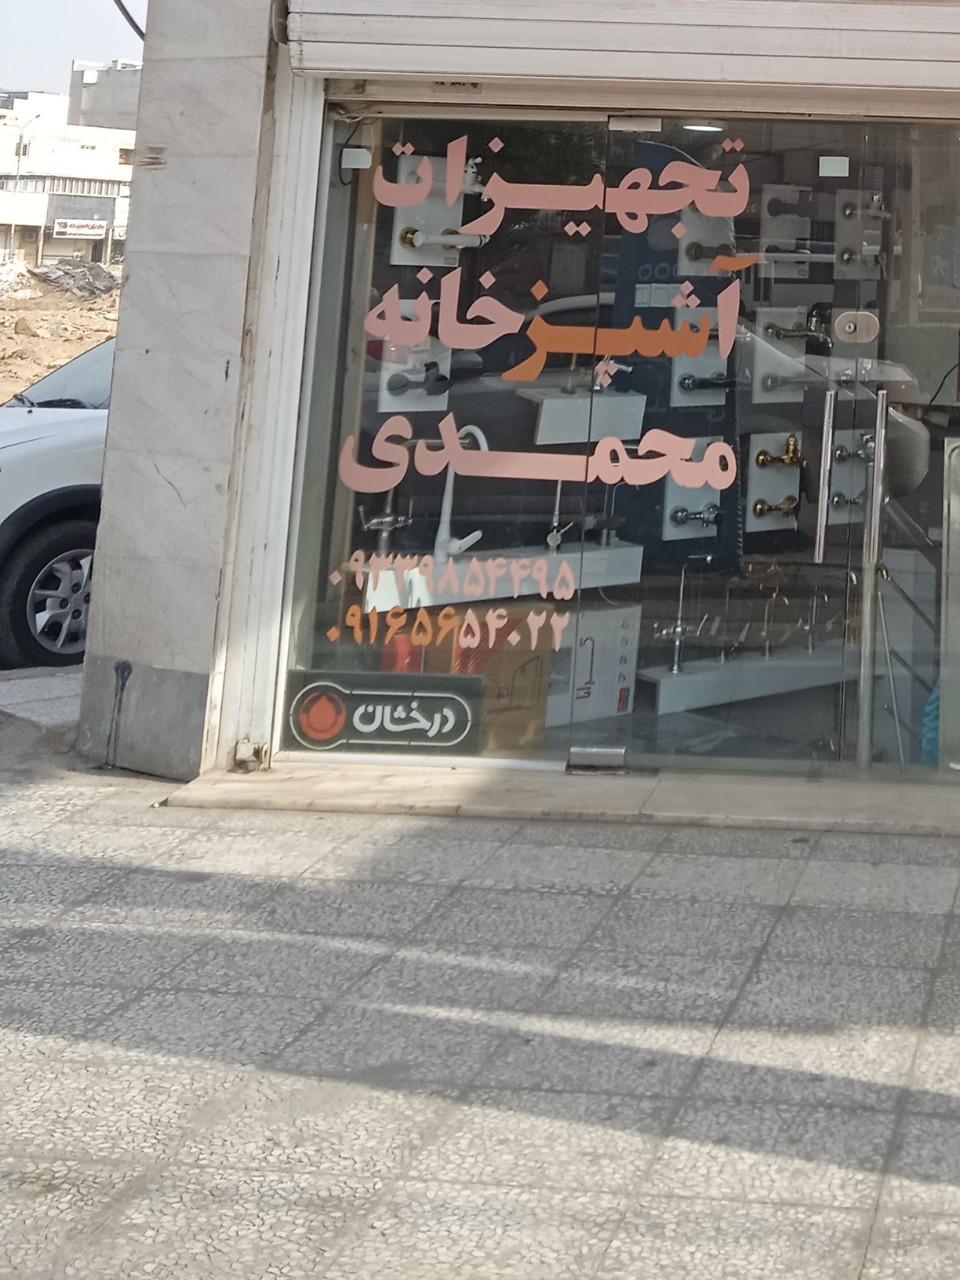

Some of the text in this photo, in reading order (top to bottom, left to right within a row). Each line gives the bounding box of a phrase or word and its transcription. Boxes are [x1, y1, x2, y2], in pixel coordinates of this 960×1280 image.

[373, 135, 751, 237] تجهیزات
[363, 253, 761, 388] آشپزخانه
[338, 412, 737, 494] محمدی
[326, 604, 570, 652] ۰۹۱۶۵۶۵۴۰۲۲
[352, 700, 456, 738] درخشان
